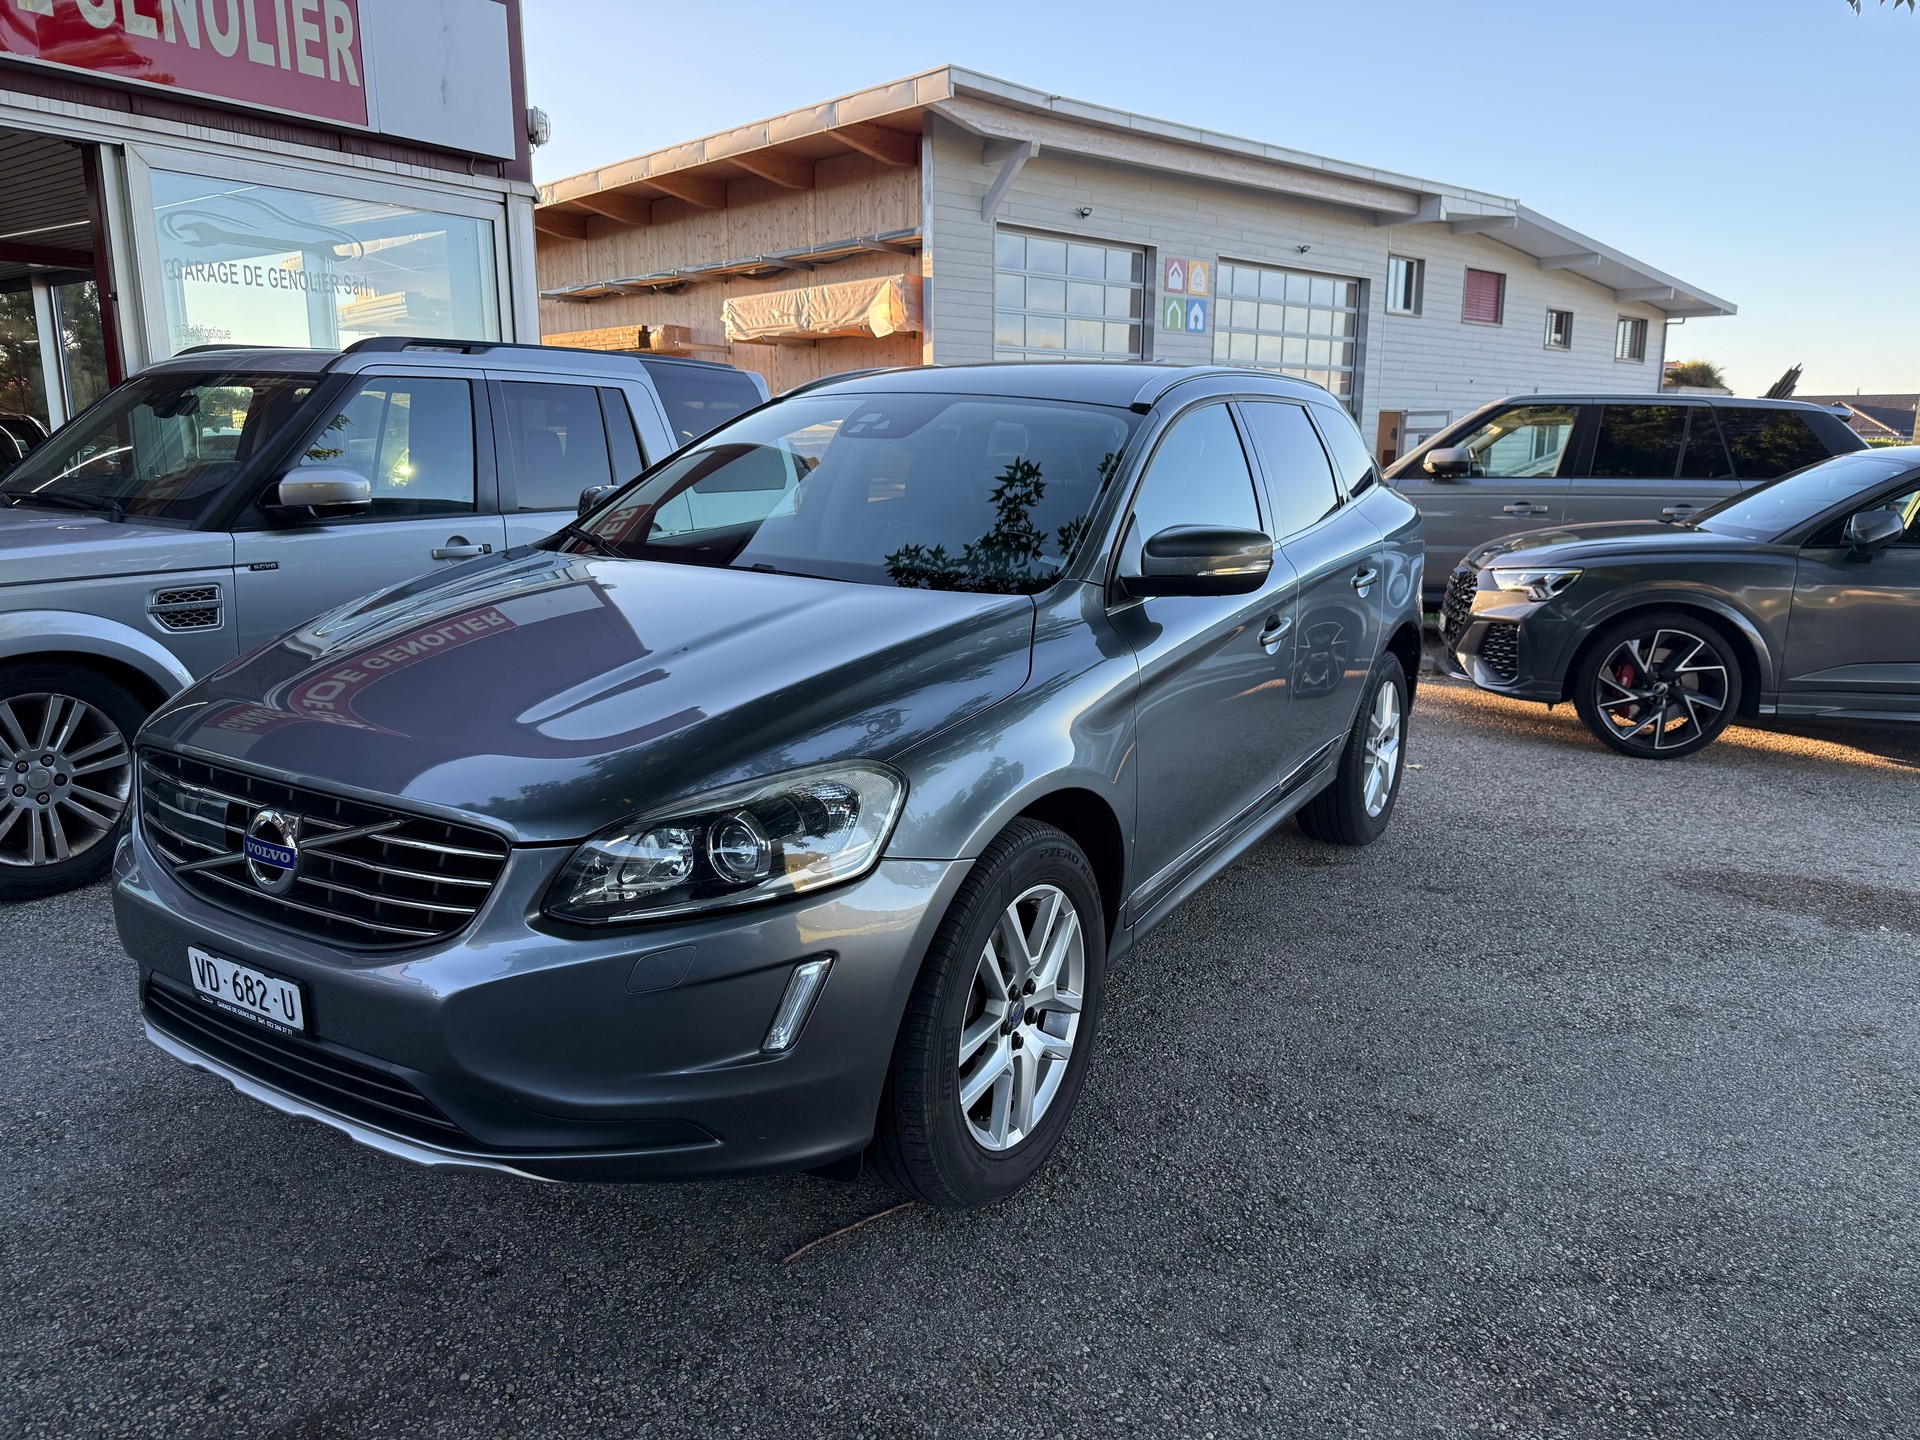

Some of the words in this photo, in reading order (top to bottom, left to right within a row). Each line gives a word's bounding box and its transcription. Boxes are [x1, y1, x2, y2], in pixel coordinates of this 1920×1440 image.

[172, 257, 239, 285] GARAGE
[243, 264, 264, 287] DE
[268, 267, 340, 295] GENOLIER
[246, 841, 291, 863] VOLVO
